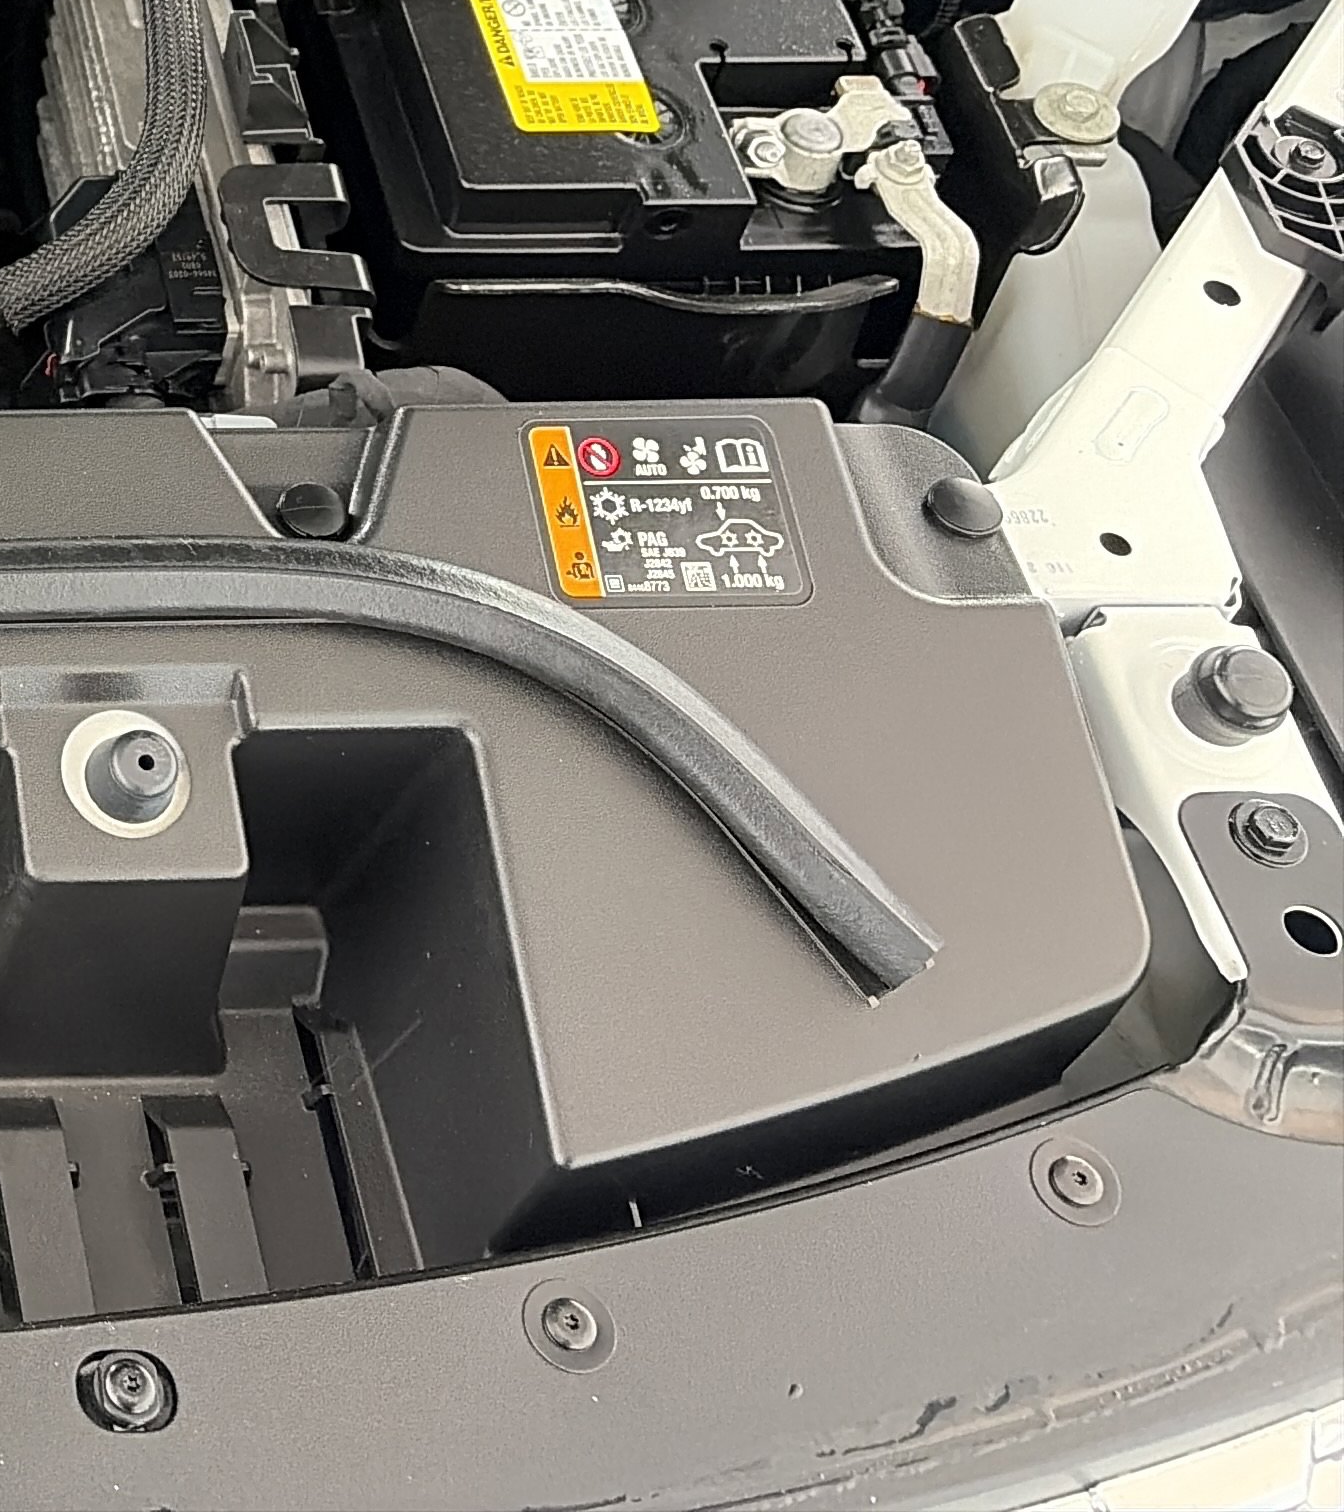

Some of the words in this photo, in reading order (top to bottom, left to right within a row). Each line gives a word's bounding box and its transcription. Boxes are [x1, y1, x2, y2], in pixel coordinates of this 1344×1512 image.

[635, 463, 667, 476] AUTO
[700, 486, 739, 500] 0.700
[740, 486, 761, 502] kg
[630, 497, 693, 515] R-1234yf
[637, 531, 669, 547] PAG
[640, 547, 661, 558] SAE
[721, 573, 763, 588] 1.000
[765, 573, 785, 591] kg
